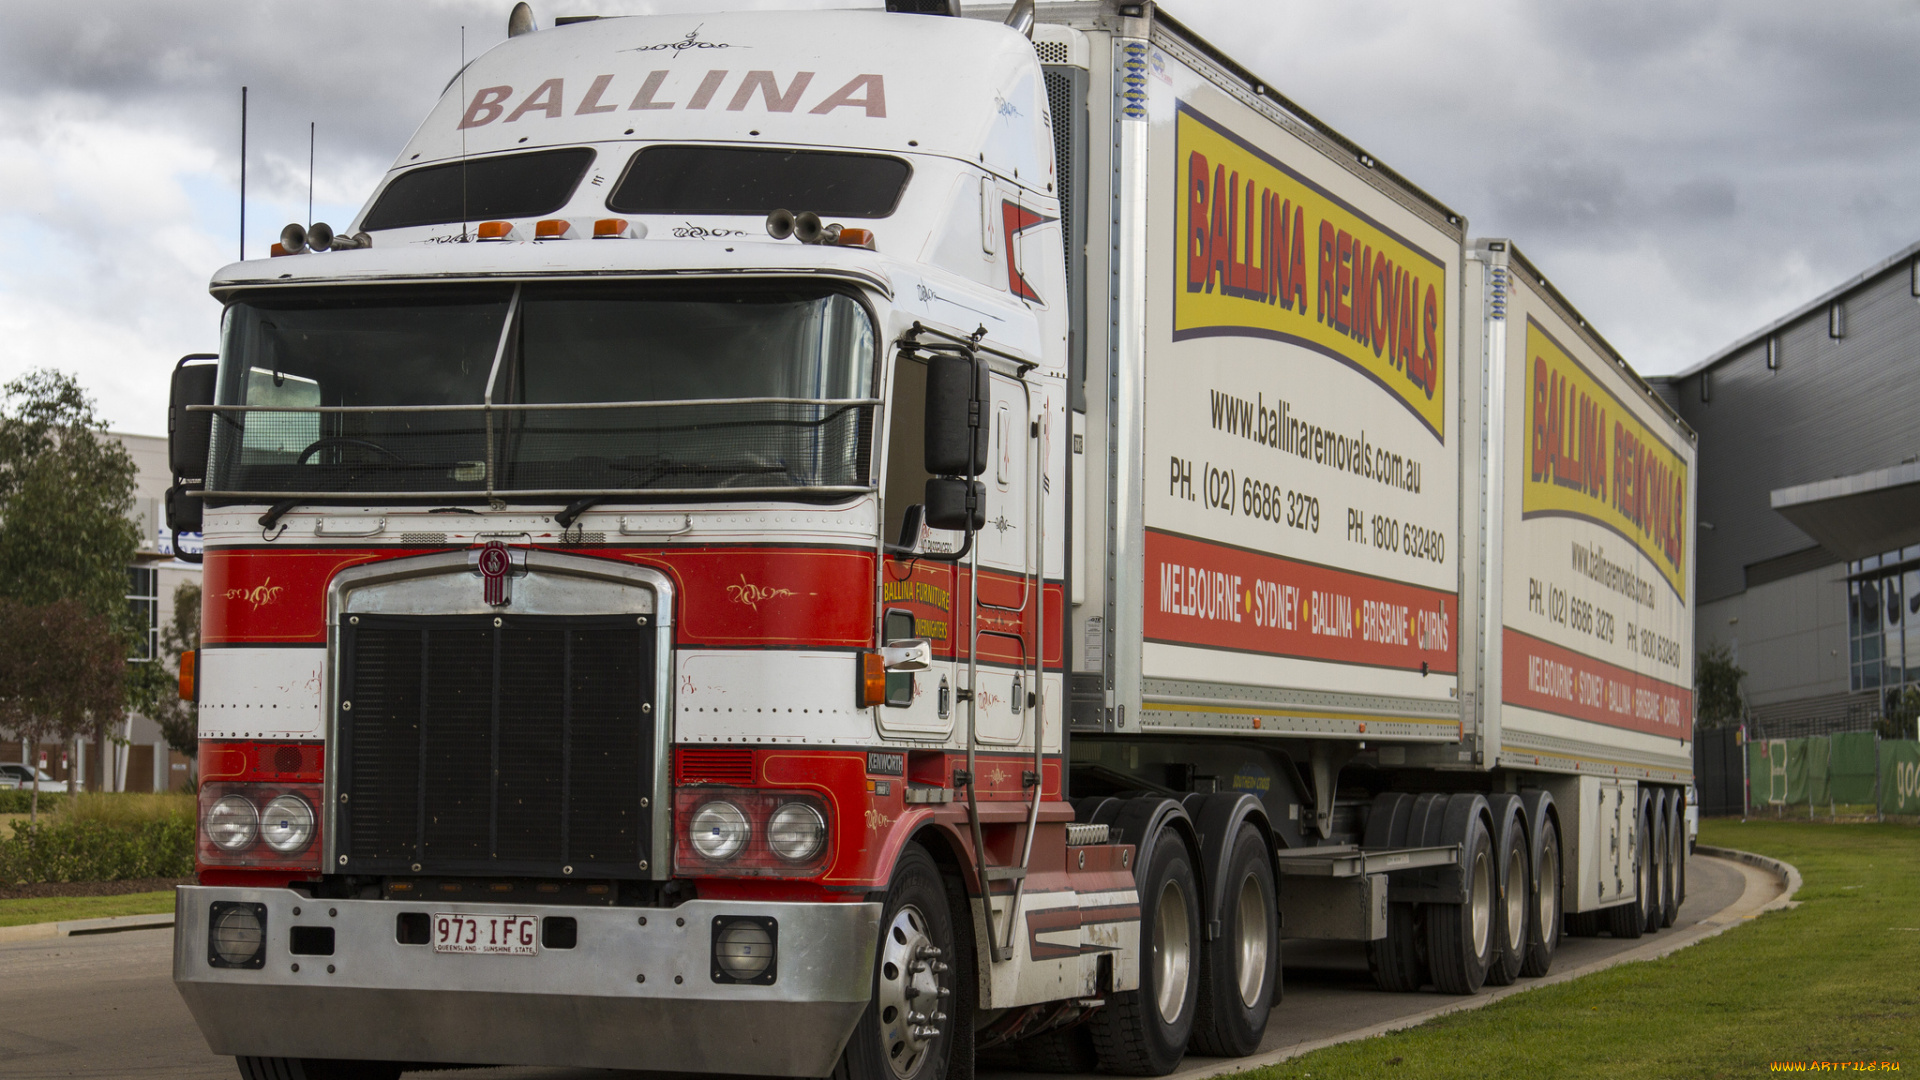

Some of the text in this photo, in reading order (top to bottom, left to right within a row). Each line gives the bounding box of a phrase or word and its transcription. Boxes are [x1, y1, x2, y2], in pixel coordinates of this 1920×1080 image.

[456, 69, 888, 131] BALLINA
[1187, 150, 1438, 400] BALLINA REMOVALS
[1210, 389, 1421, 494] www.ballinaremovals.com.au
[1532, 355, 1682, 575] BALLINA REMOVALS
[1170, 456, 1320, 534] PH. (02) 6686 3279
[1347, 507, 1445, 564] PH. 1800 632480
[883, 581, 950, 613] BALLINA FURNITURE
[1160, 562, 1449, 652] MELBOURNE SYDNEY BALLINA BRISBANE CAIRNS
[1571, 540, 1656, 610] www.ballinaremovals.com.au
[1529, 577, 1614, 644] PH. (02) 6686 3279
[1640, 627, 1656, 660] 1800
[1657, 634, 1681, 669] 632480
[1528, 654, 1681, 727] MELBOURNE SYDNEY BALLINA BRISBANE CAIRNS
[868, 752, 904, 771] KENWORTH
[437, 917, 534, 946] 973 IFG
[437, 944, 477, 953] QUEENSLAND
[515, 946, 533, 954] STATE
